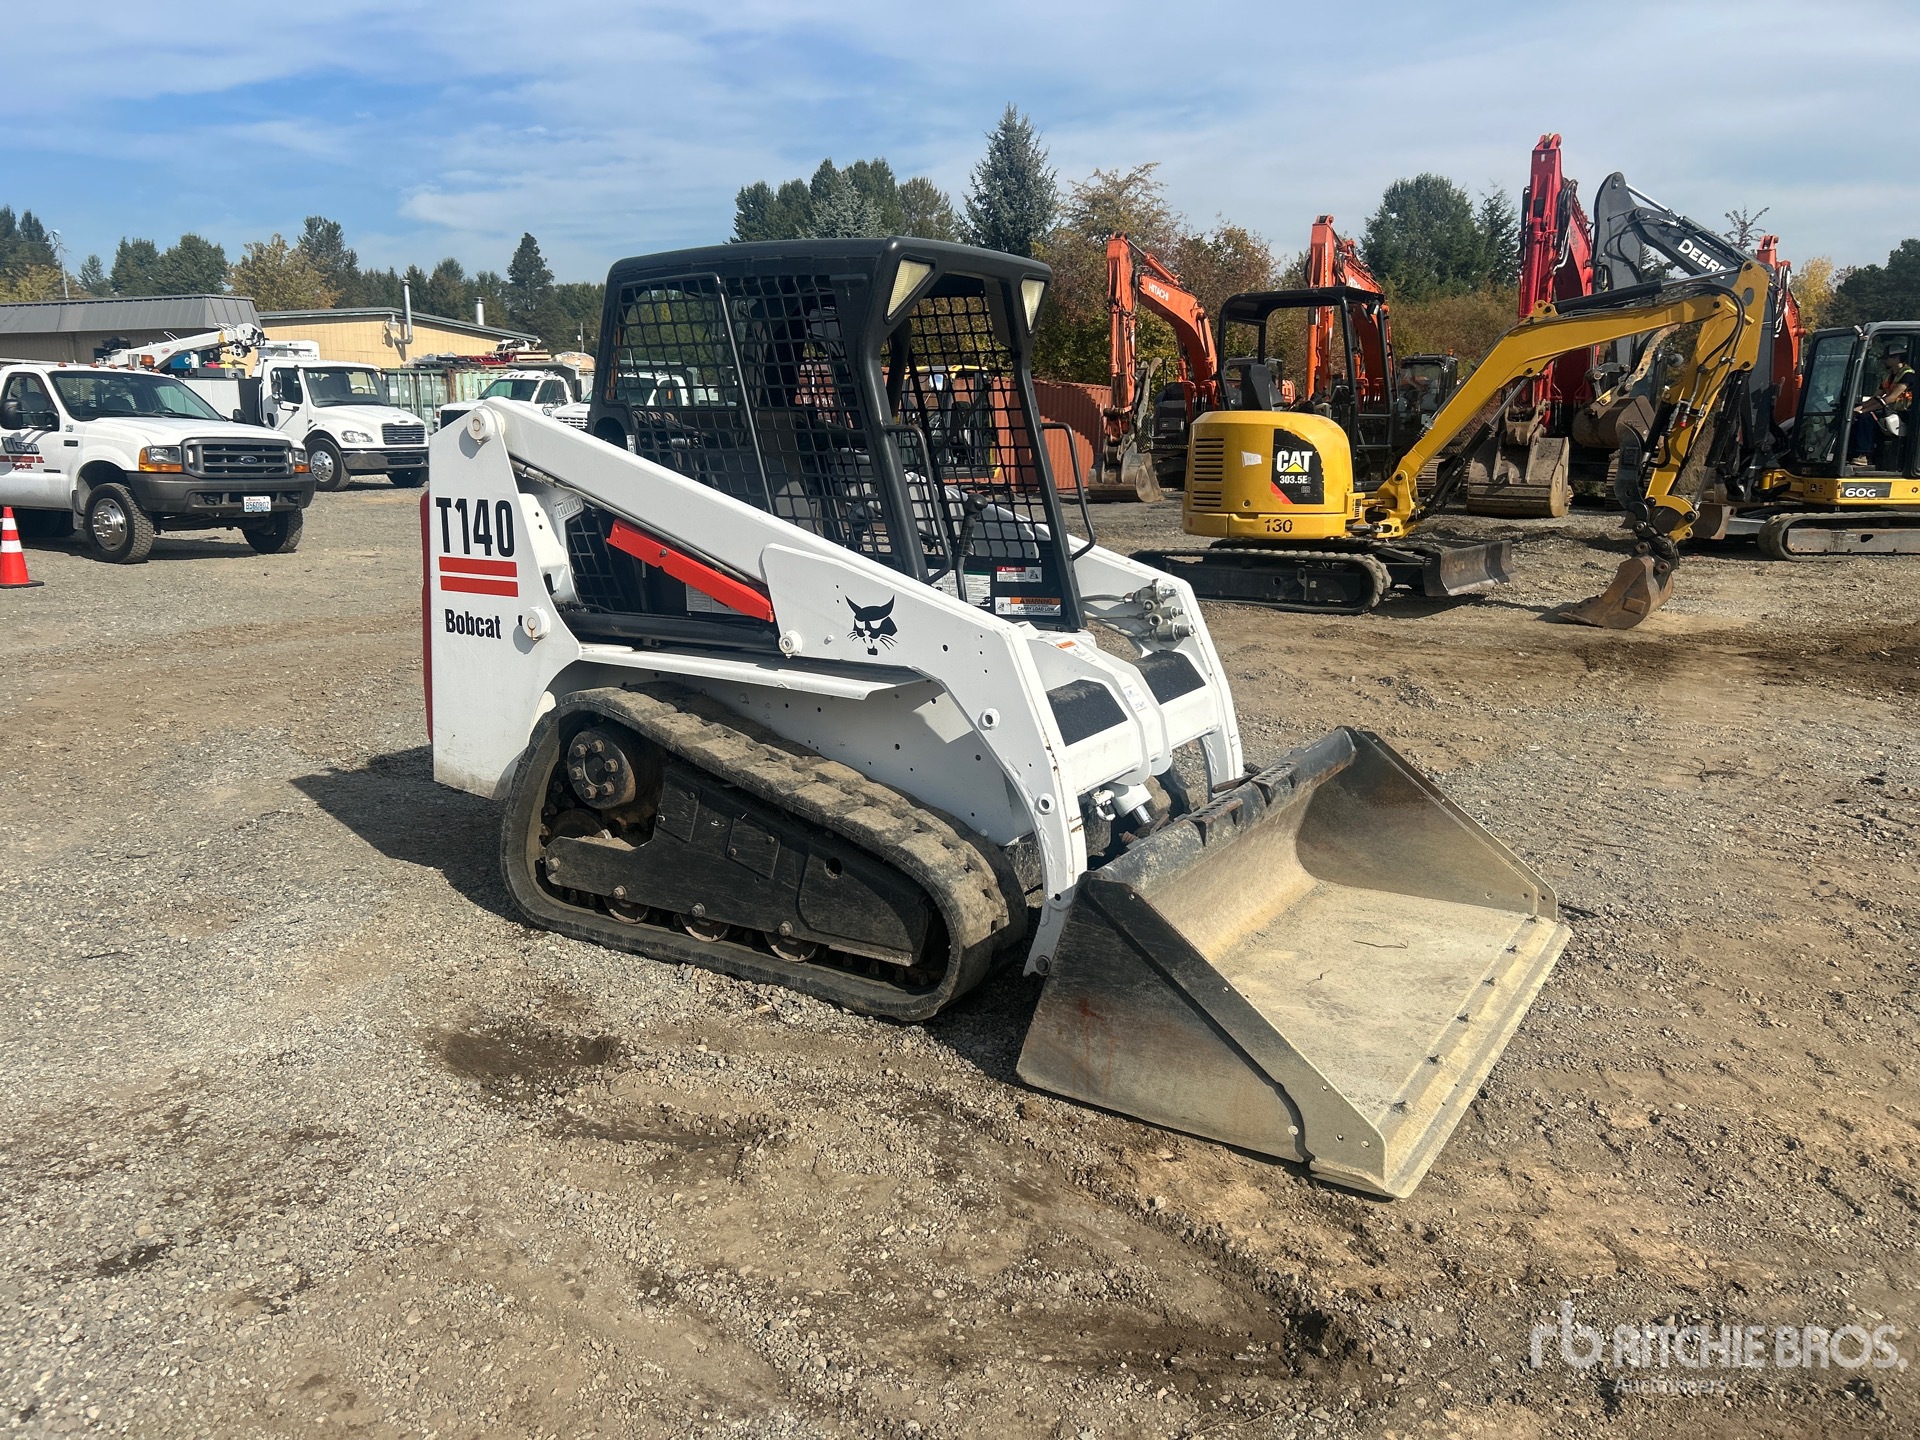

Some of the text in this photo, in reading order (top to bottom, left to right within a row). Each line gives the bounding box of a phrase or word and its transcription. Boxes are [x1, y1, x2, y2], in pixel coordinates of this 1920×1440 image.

[1148, 282, 1169, 302] HITACHI
[1276, 450, 1313, 473] CAT
[1845, 488, 1877, 498] 60G
[435, 497, 516, 558] T140
[1263, 518, 1294, 533] 130
[445, 608, 502, 640] Bobcat
